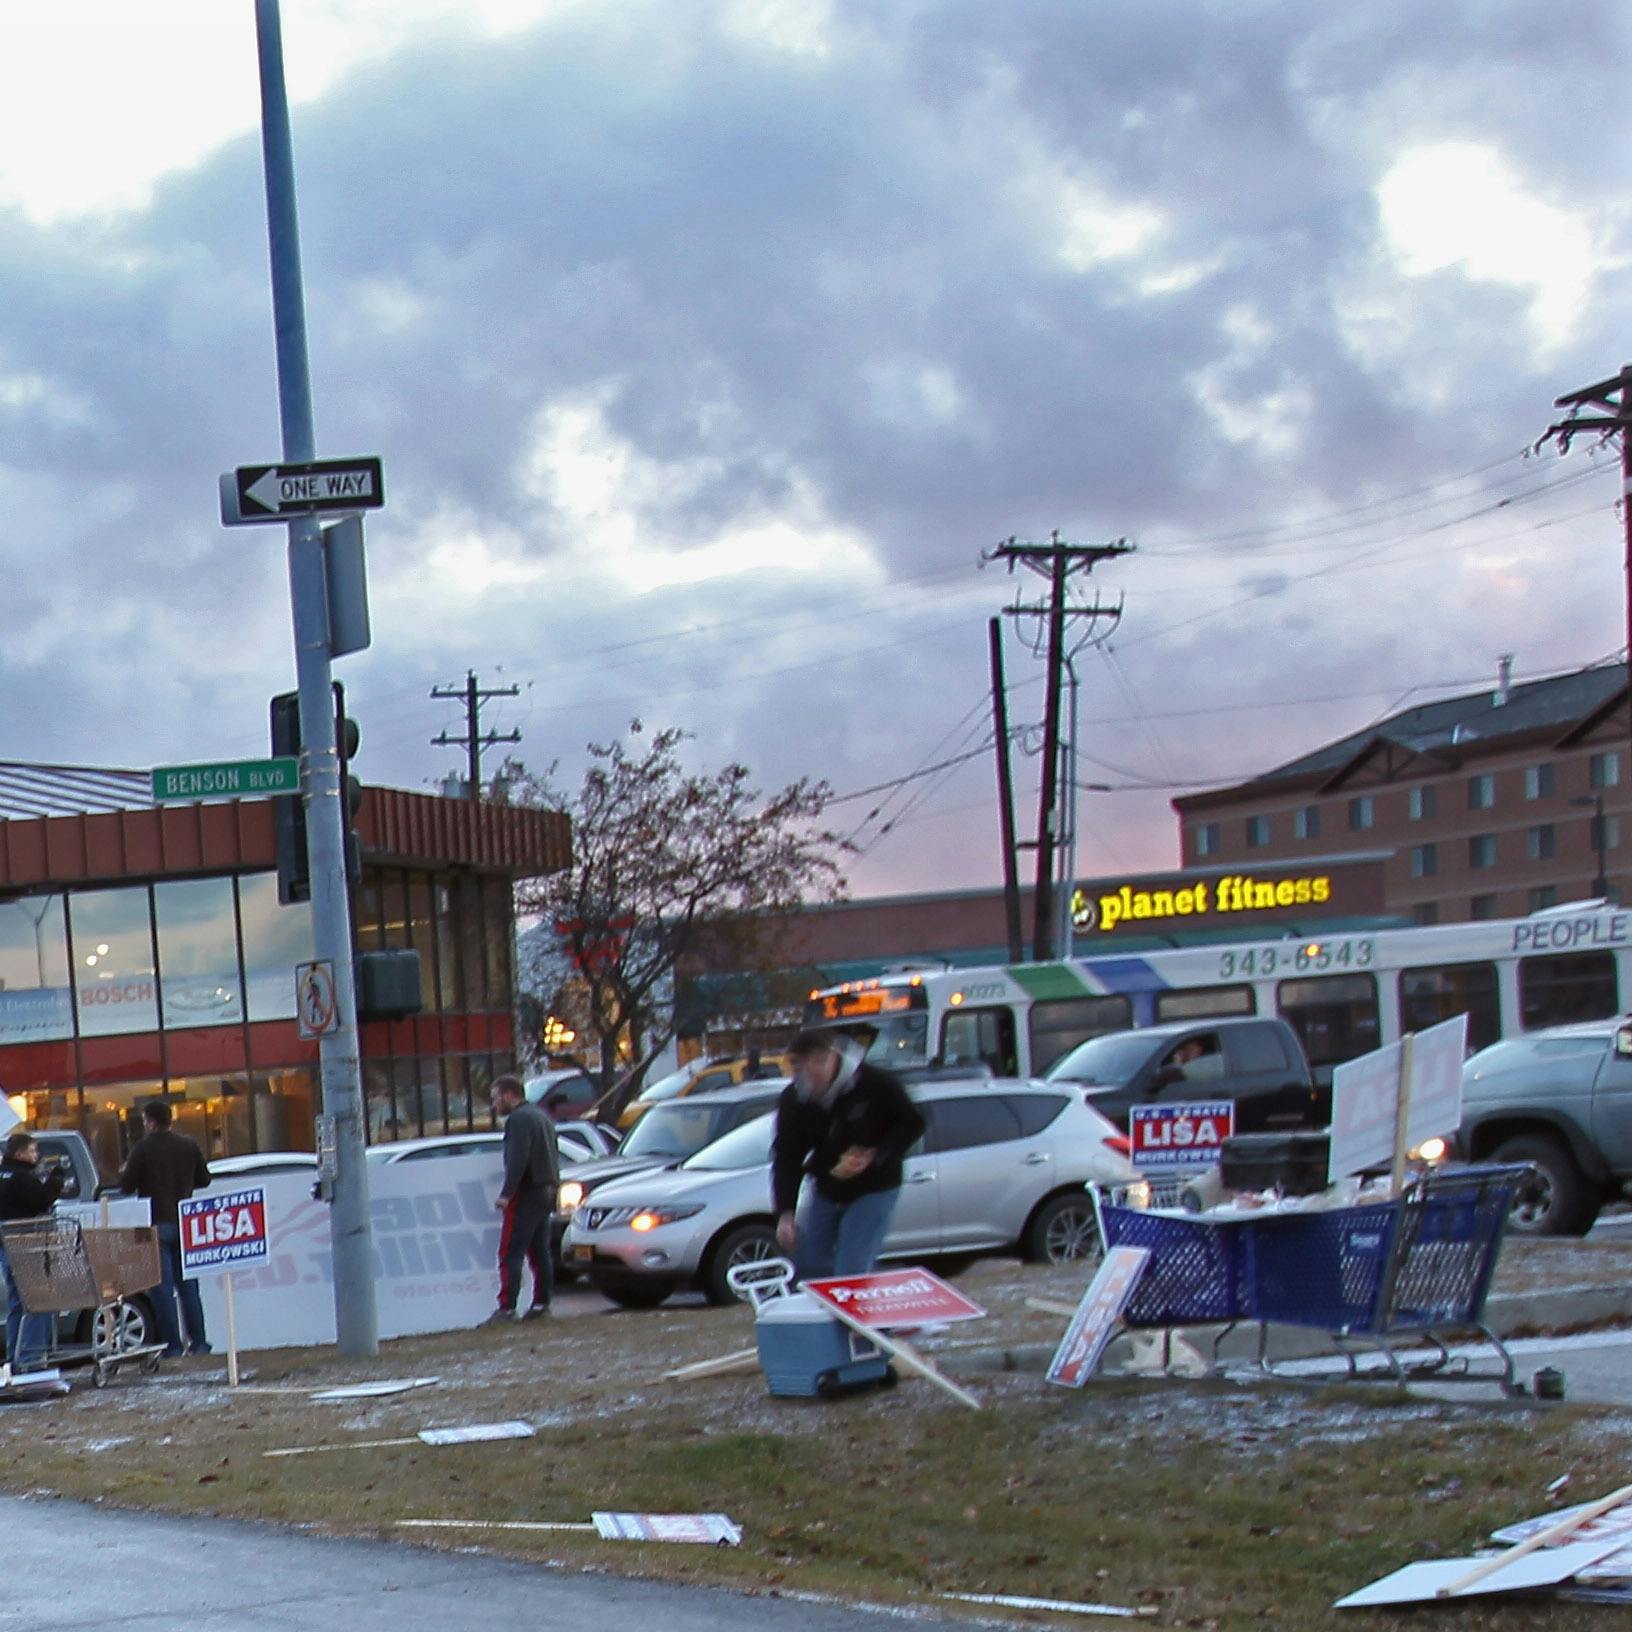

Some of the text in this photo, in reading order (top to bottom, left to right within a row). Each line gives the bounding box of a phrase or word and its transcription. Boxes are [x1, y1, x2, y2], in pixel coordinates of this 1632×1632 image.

[281, 471, 367, 499] ONE WAY
[166, 770, 284, 794] BENSON BLVD
[1100, 874, 1330, 930] planet fitness
[1511, 915, 1627, 952] PEOPLE
[82, 983, 153, 1006] BOSCH
[1143, 1118, 1217, 1147] LISA
[183, 1192, 260, 1215] U.S. SENATE
[191, 1208, 256, 1246] LISA
[186, 1240, 264, 1265] MURKOWSKI
